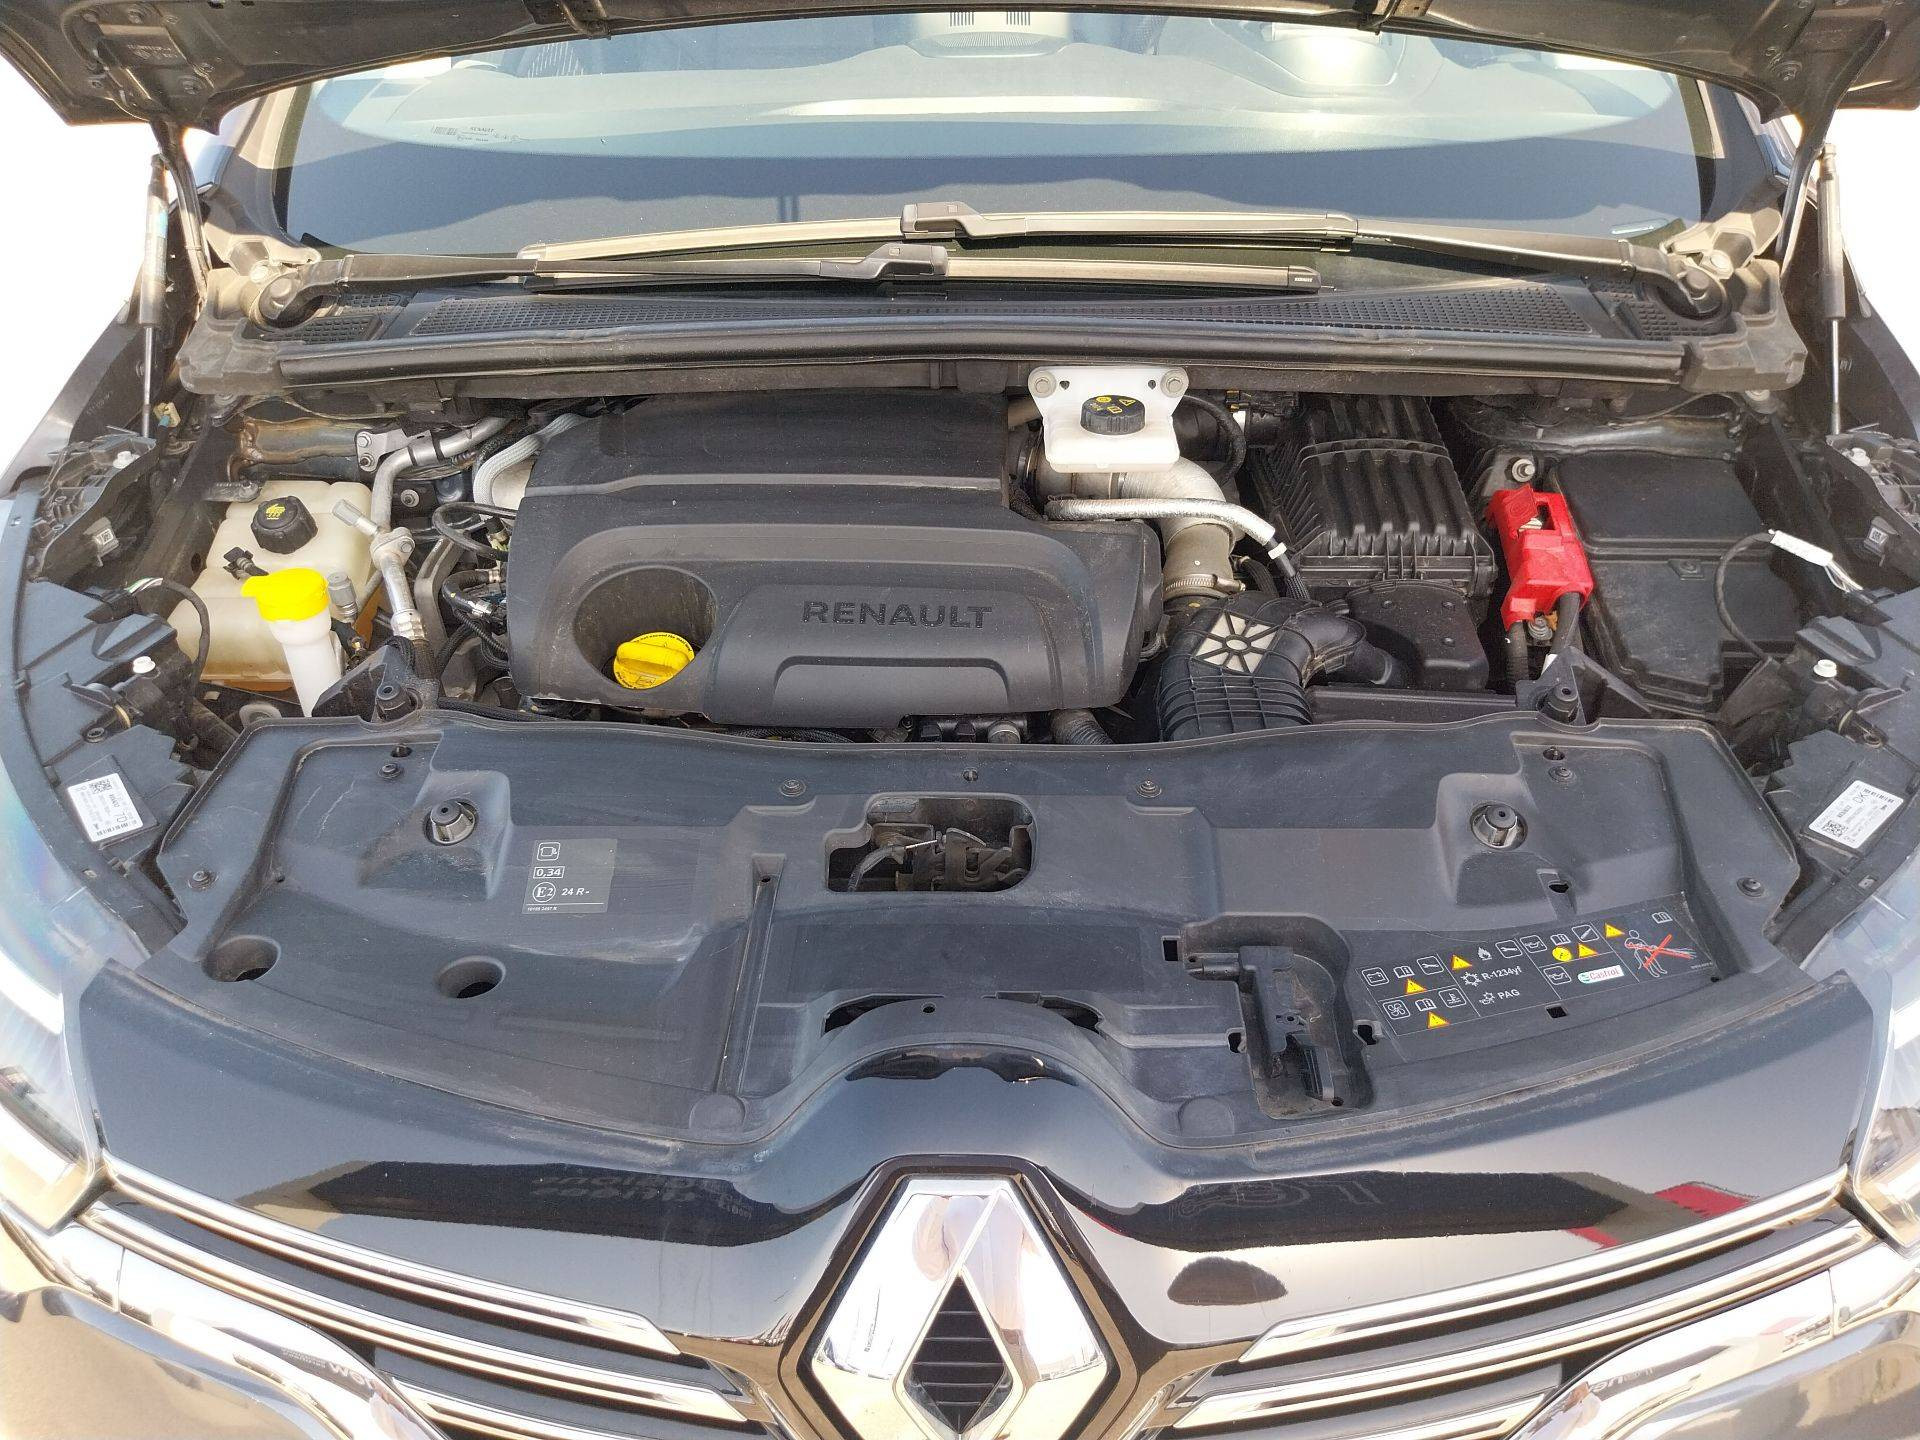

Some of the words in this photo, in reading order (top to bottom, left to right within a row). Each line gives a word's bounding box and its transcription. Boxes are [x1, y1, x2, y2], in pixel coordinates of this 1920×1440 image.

[802, 601, 993, 629] RENAULT
[561, 887, 574, 896] 24
[1481, 965, 1523, 981] R-1234yf
[1497, 988, 1521, 1000] PAG
